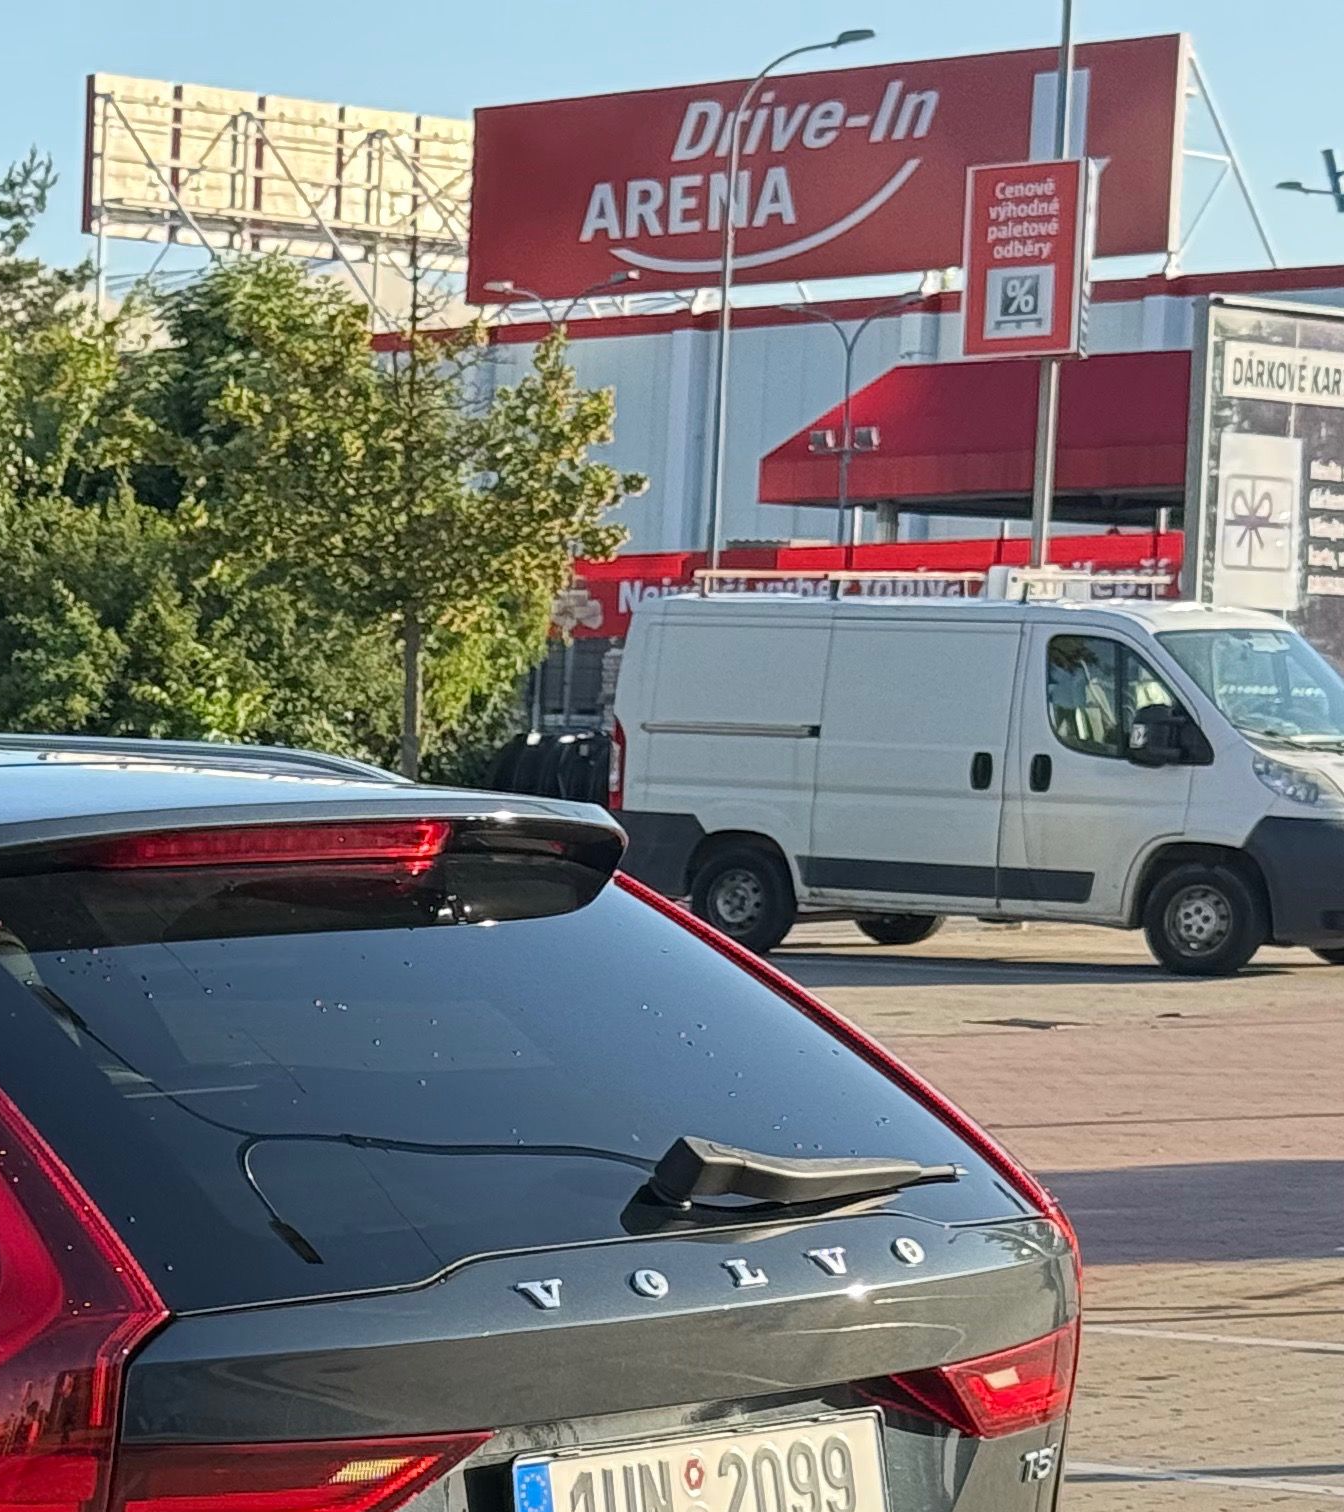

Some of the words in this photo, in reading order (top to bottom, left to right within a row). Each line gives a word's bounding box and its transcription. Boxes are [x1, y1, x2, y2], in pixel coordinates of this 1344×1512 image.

[670, 79, 940, 162] Drive-In
[578, 166, 797, 243] ARENA
[988, 199, 1060, 222] výhodné
[987, 219, 1059, 244] paletové
[993, 242, 1053, 260] odběry
[1232, 350, 1307, 393] DÁRKOVÉ
[515, 1236, 927, 1310] VOLVO
